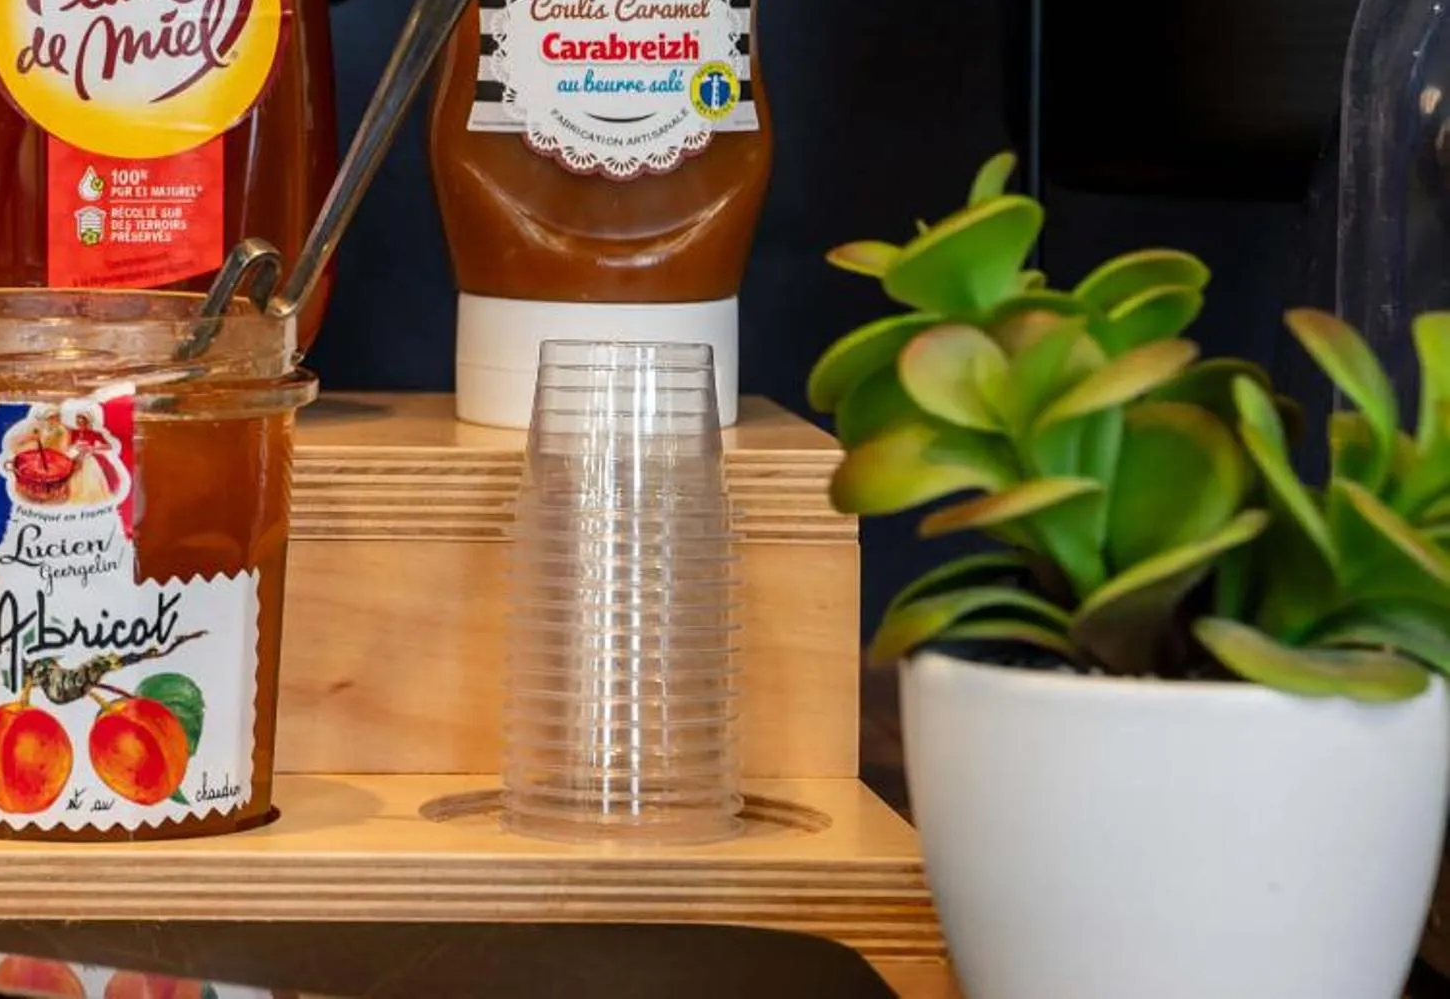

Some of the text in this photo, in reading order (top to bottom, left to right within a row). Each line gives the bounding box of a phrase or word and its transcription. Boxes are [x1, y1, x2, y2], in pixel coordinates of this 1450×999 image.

[16, 26, 69, 75] de
[542, 31, 699, 61] Carabreizh
[557, 80, 580, 92] au
[583, 68, 647, 93] beurre
[649, 69, 685, 92] salé
[551, 108, 689, 146] FABRICATION ARTISANALE
[111, 219, 132, 230] DES
[40, 554, 122, 597] Georgelin
